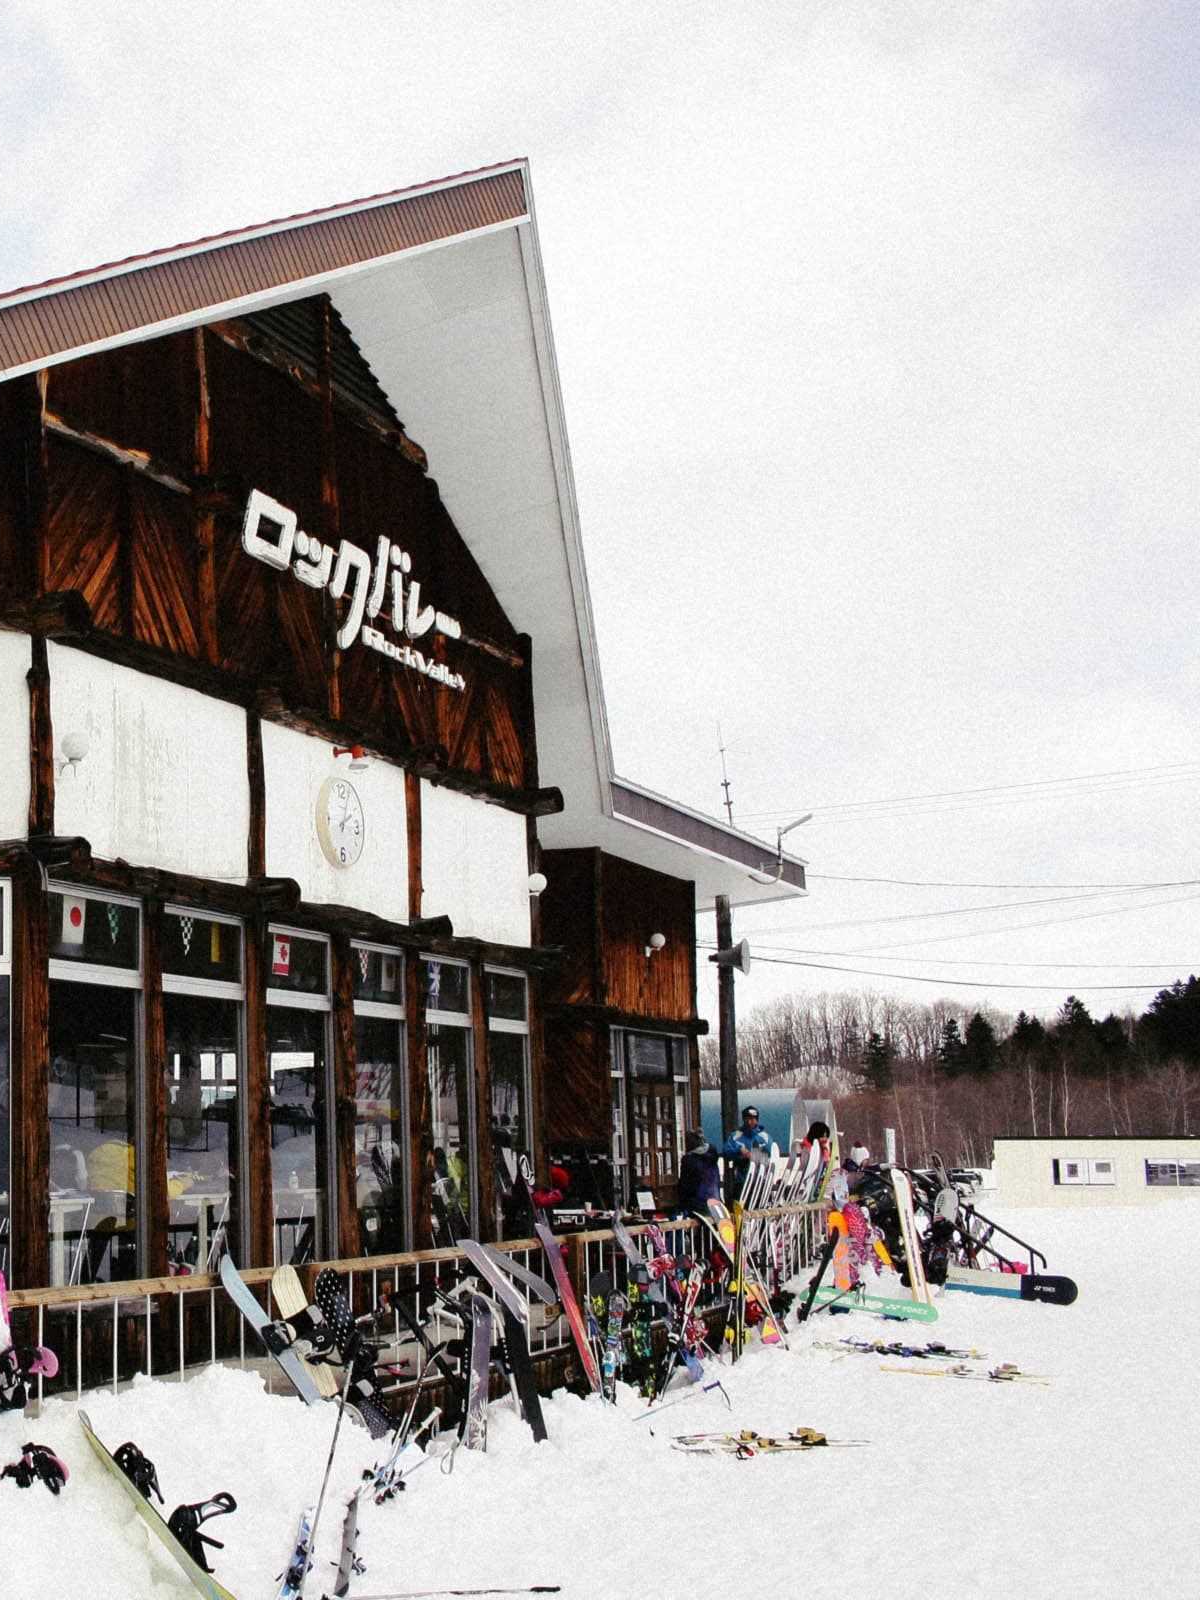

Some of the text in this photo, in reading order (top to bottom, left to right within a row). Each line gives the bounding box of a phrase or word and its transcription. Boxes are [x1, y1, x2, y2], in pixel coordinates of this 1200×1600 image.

[243, 488, 461, 650] ロックバレー
[336, 784, 346, 800] 12
[354, 819, 360, 835] 3
[340, 847, 346, 863] 6
